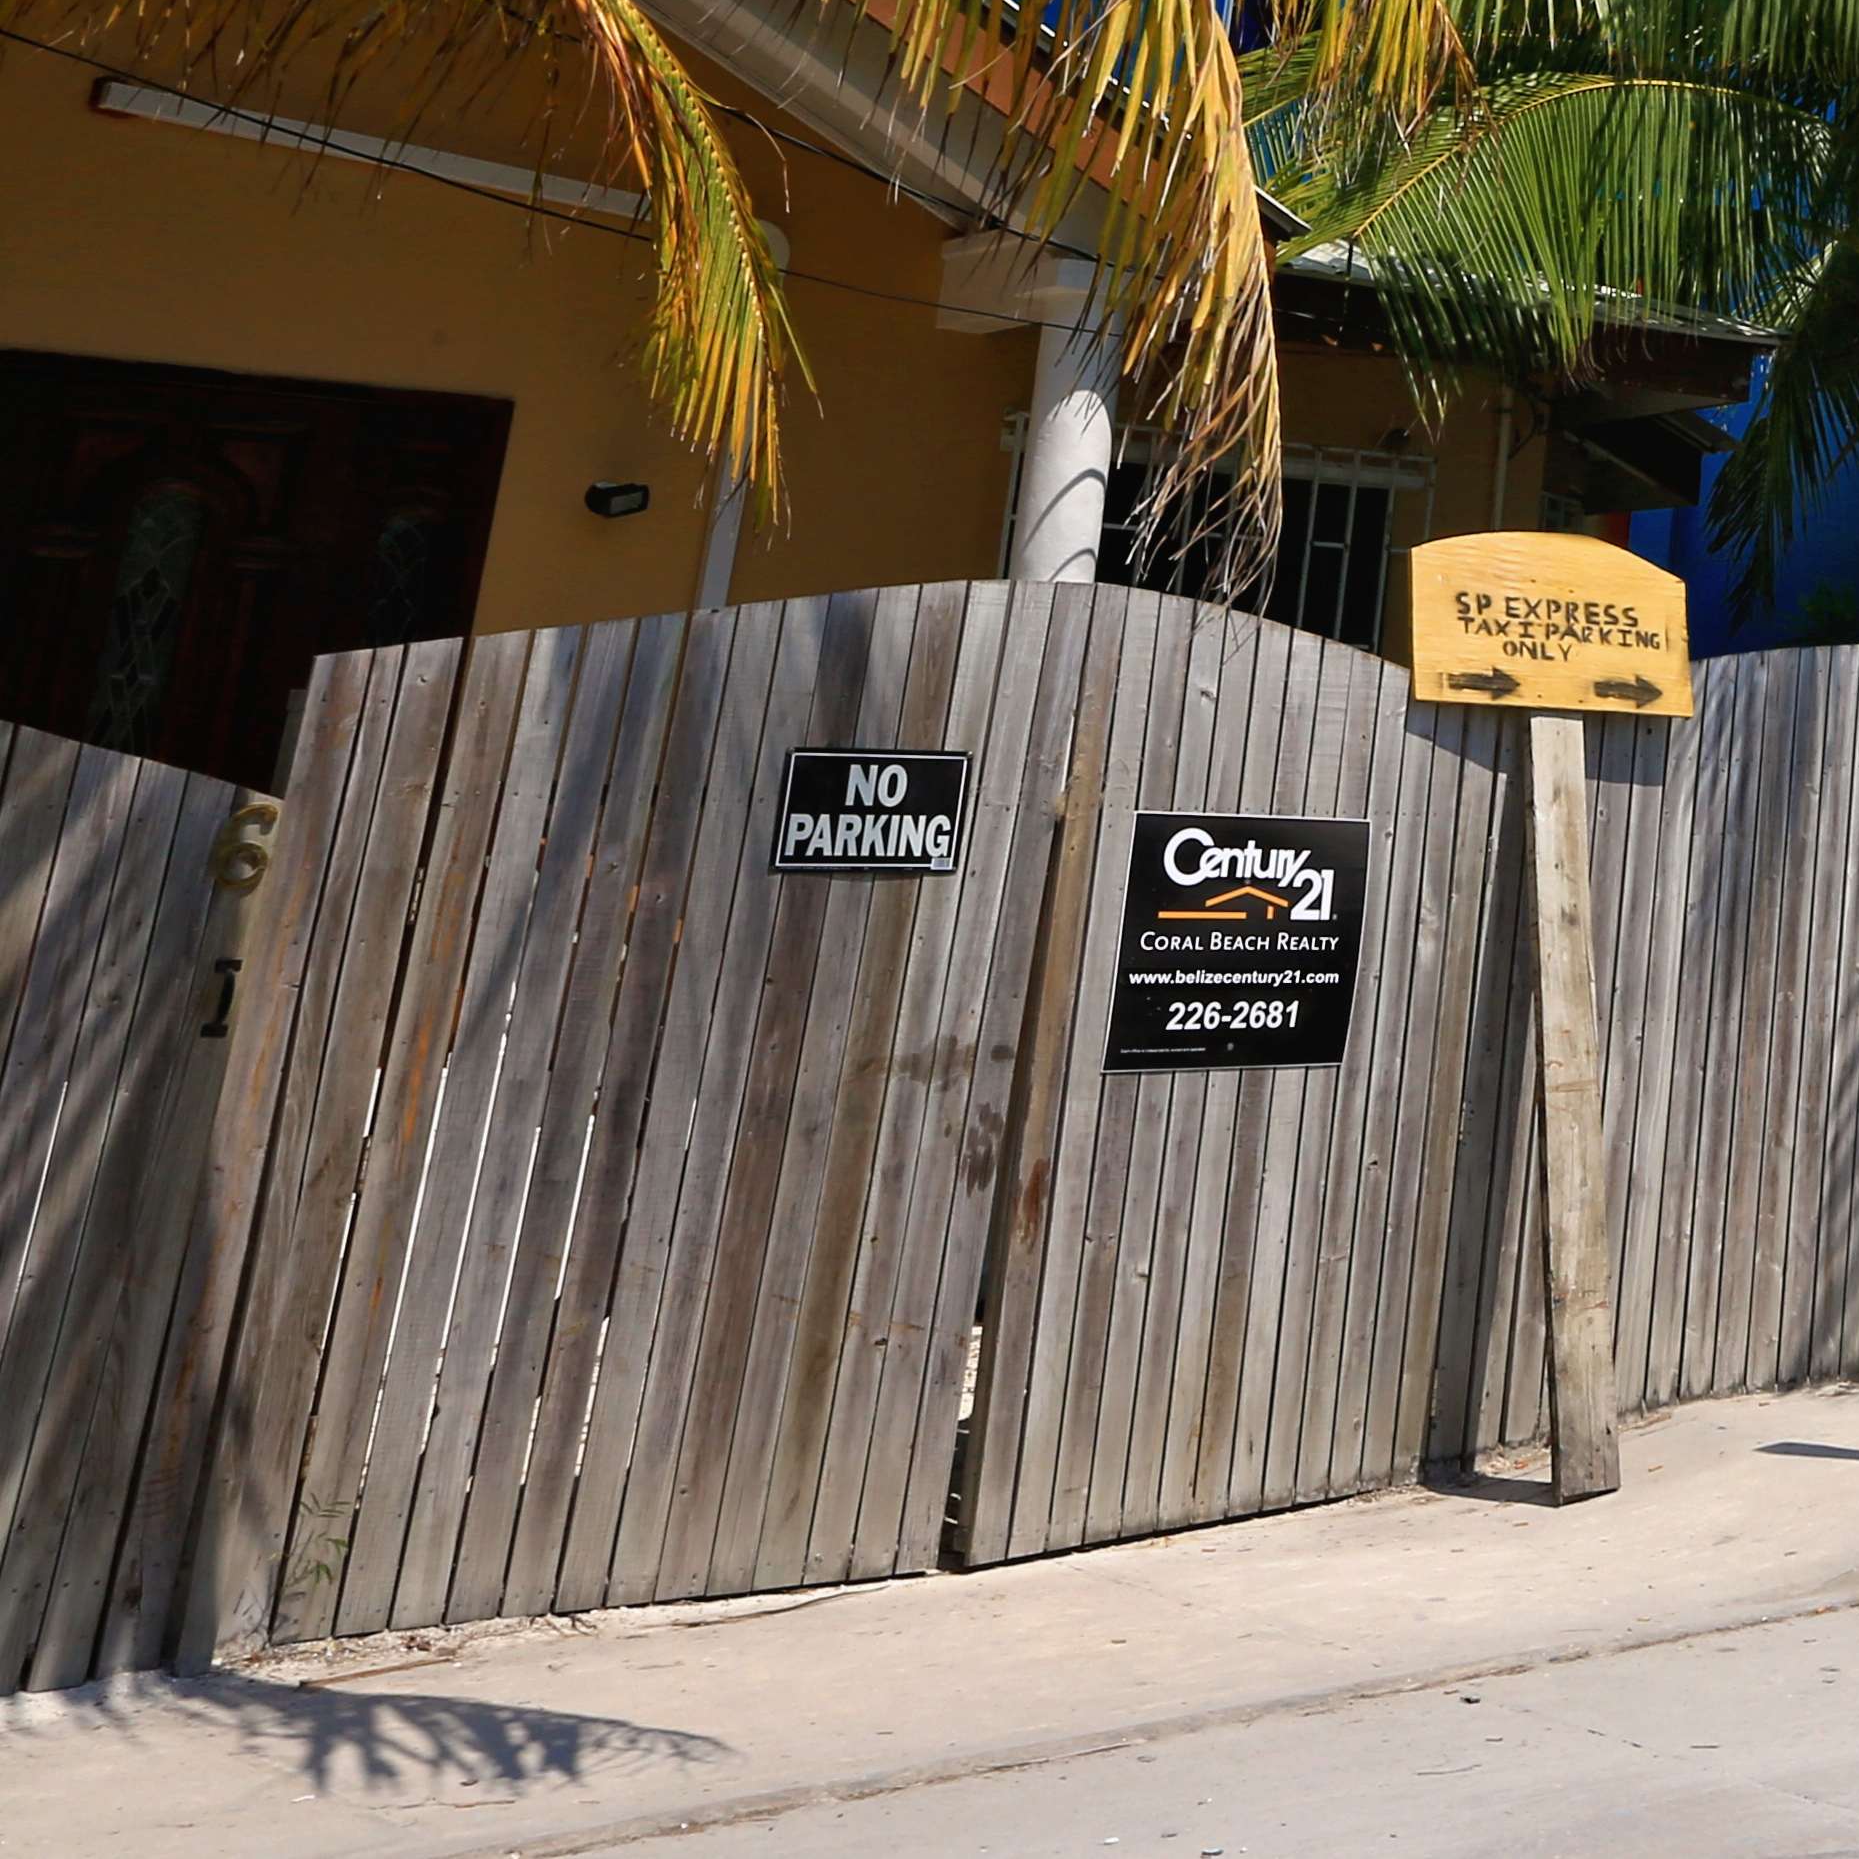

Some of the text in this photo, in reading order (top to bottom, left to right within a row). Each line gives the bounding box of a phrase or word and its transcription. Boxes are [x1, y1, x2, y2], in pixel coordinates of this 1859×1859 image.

[1455, 591, 1640, 628] SP EXPRESS
[1457, 616, 1661, 650] TAXI PARKING
[1503, 640, 1573, 662] ONLY
[844, 763, 909, 808] NO
[212, 801, 278, 896] 6
[783, 813, 952, 858] PARKING
[1164, 827, 1311, 887] Century
[1290, 869, 1335, 920] 21
[1140, 931, 1340, 951] CORAL BEACH REALTY
[1128, 969, 1339, 987] www.belizecentury21.com
[1165, 1000, 1300, 1031] 226-2681
